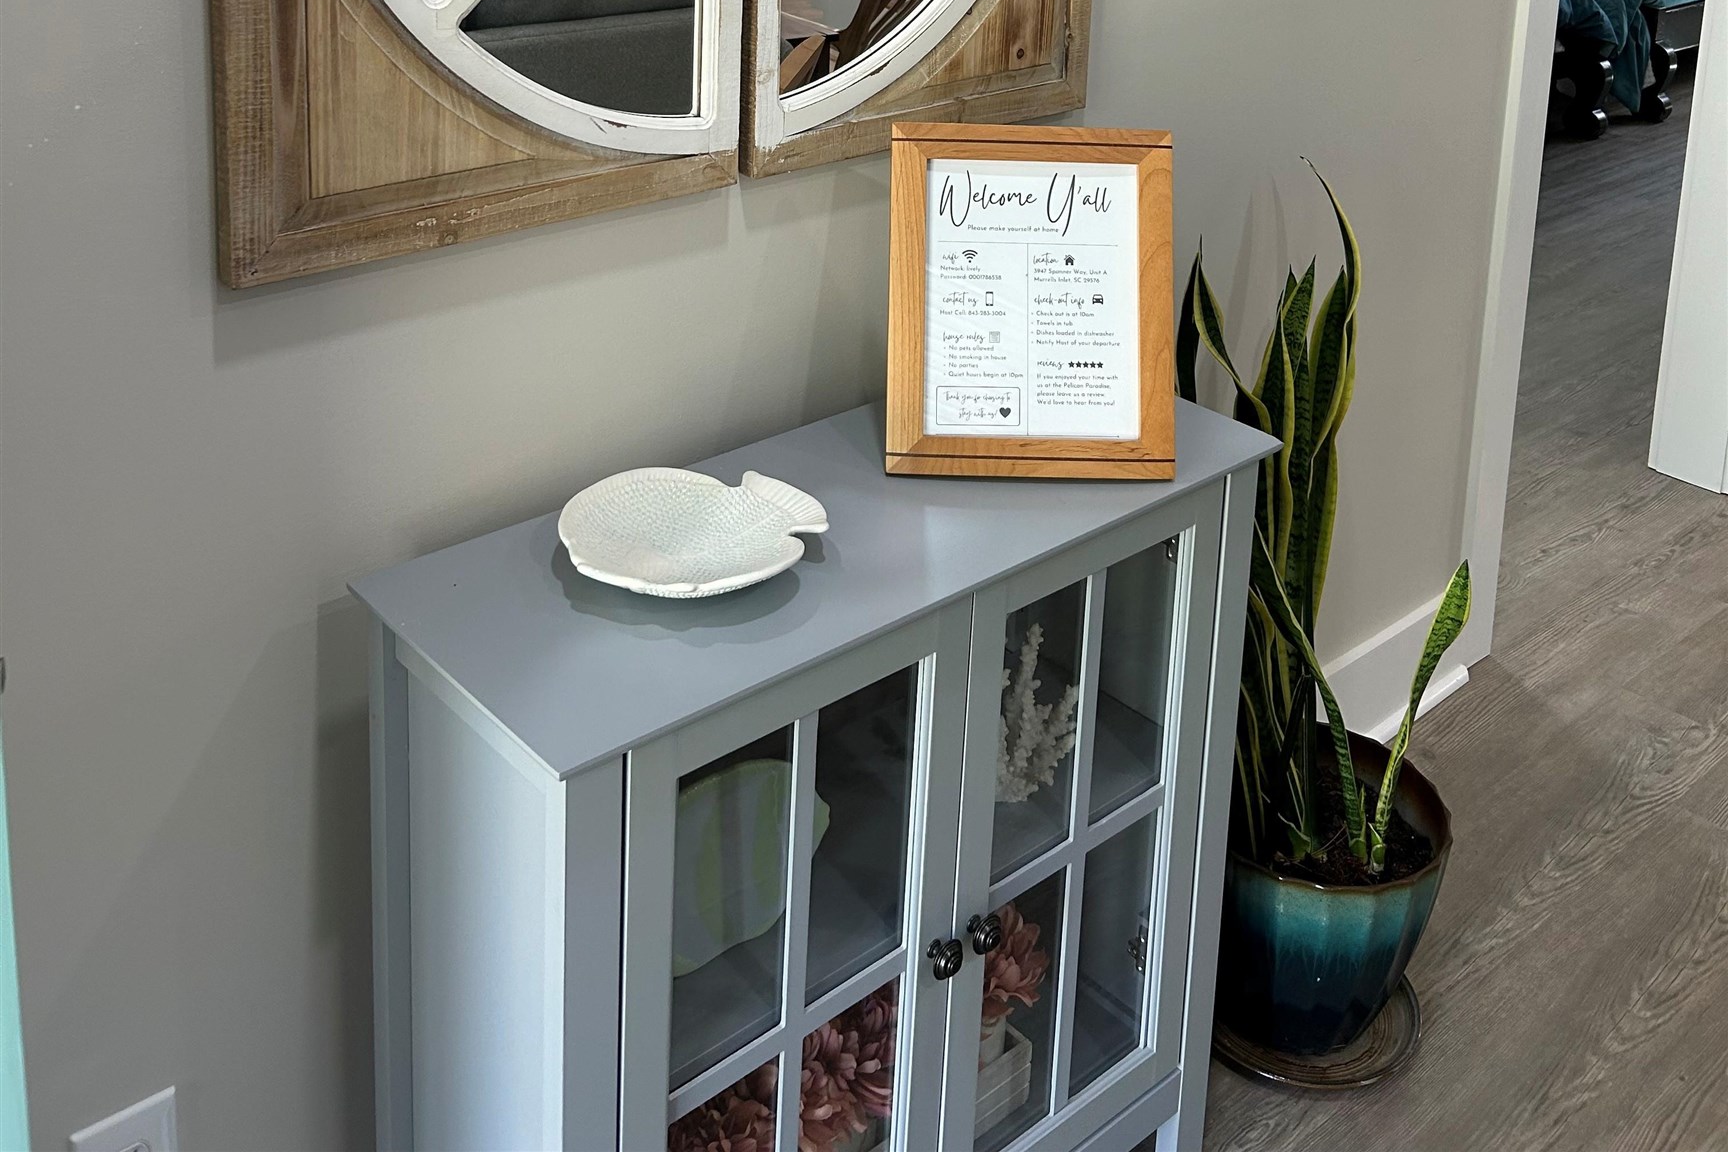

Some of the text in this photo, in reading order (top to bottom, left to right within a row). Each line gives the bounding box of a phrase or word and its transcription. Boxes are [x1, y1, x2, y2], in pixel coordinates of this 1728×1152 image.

[940, 170, 1112, 237] Welcome Y'all
[1033, 253, 1059, 265] location
[943, 292, 969, 306] contact
